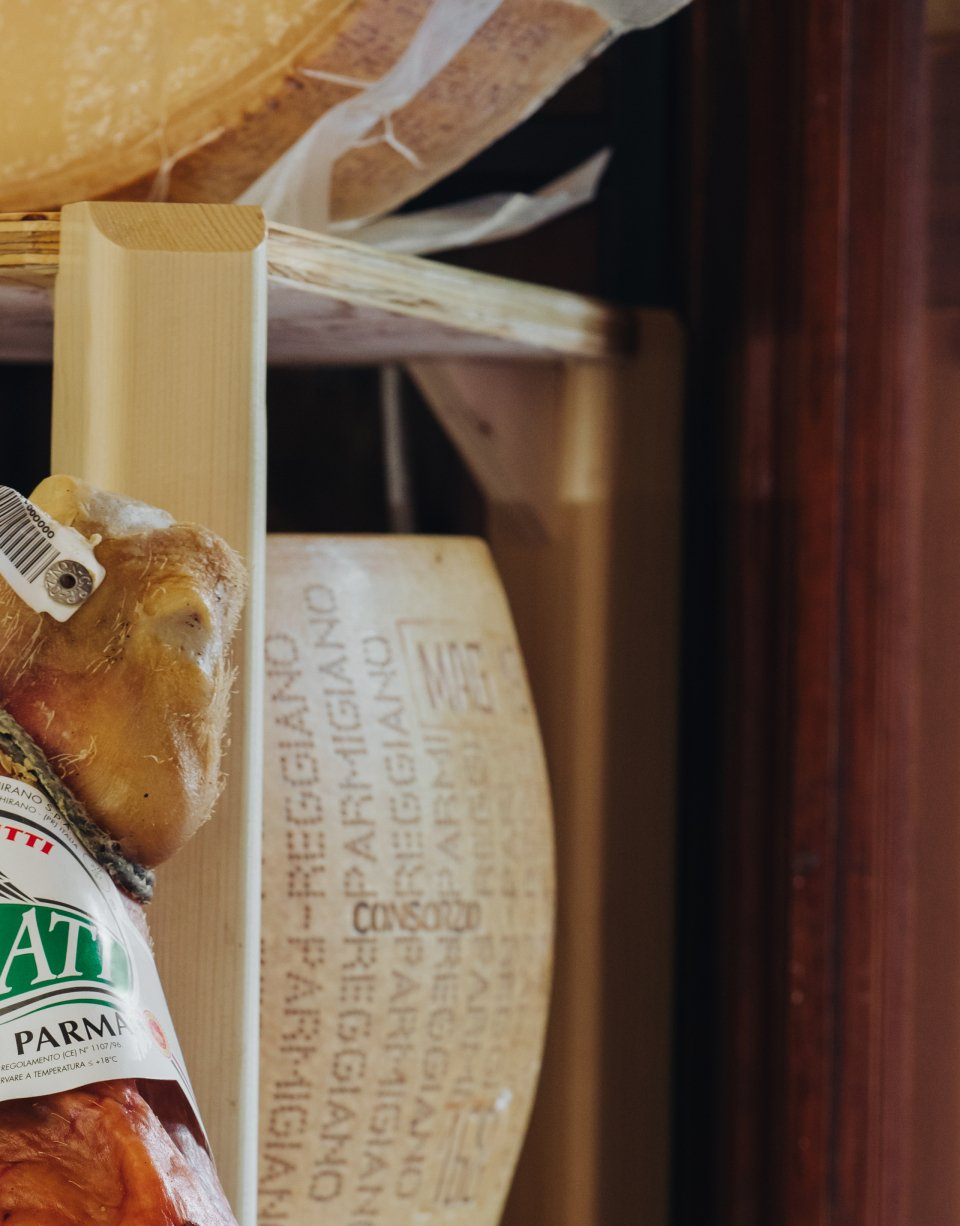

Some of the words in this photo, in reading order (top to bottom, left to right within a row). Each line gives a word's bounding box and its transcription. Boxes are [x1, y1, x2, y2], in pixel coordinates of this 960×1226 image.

[264, 633, 326, 899] REGGIANO
[303, 583, 378, 899] PARMIGIANO
[362, 635, 426, 898] REGGIANO
[1, 1052, 61, 1072] REGOLAMENTO
[62, 1049, 79, 1061] (CE)
[14, 1011, 134, 1056] PARMA
[34, 1061, 86, 1078] TEMPERATURA
[95, 1055, 118, 1065] +18°C
[308, 936, 378, 1203] REGGIANO
